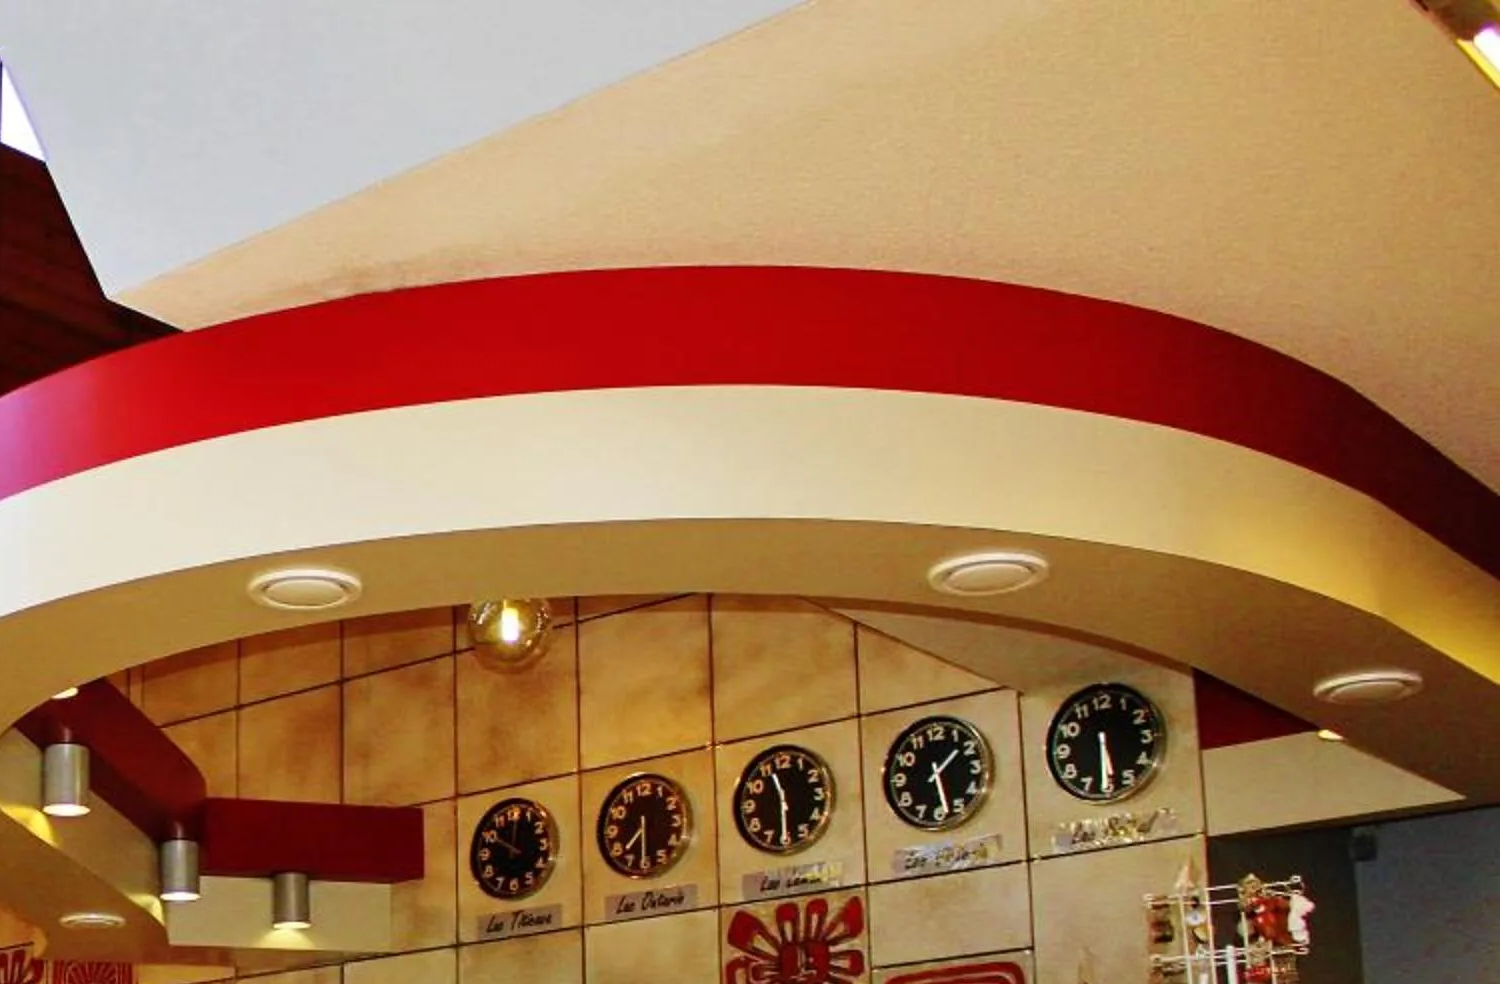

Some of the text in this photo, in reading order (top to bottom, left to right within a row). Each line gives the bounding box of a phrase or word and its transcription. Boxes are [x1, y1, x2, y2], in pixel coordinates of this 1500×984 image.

[1092, 694, 1112, 710] 12
[1120, 698, 1127, 710] 1
[1075, 704, 1089, 718] 11
[1132, 709, 1146, 724] 2
[927, 726, 944, 740] 12
[952, 730, 958, 742] 1
[1059, 722, 1080, 737] 10
[1140, 729, 1153, 743] 3
[911, 736, 924, 749] 11
[964, 741, 976, 756] 2
[1057, 744, 1071, 759] 9
[1137, 751, 1148, 764] 4
[774, 753, 791, 769] 12
[797, 756, 803, 769] 1
[896, 753, 916, 767] 10
[970, 760, 981, 774] 3
[760, 763, 772, 777] 11
[808, 770, 819, 783] 2
[1064, 763, 1077, 778] 8
[1122, 769, 1134, 785] 5
[746, 780, 764, 794] 10
[894, 773, 907, 787] 9
[1081, 777, 1093, 791] 7
[814, 787, 824, 801] 3
[966, 782, 978, 794] 4
[742, 799, 756, 813] 9
[900, 792, 912, 807] 8
[953, 798, 964, 813] 5
[810, 809, 820, 820] 4
[916, 805, 927, 818] 7
[934, 806, 946, 820] 6
[750, 818, 761, 832] 8
[798, 824, 809, 838] 5
[764, 830, 775, 843] 7
